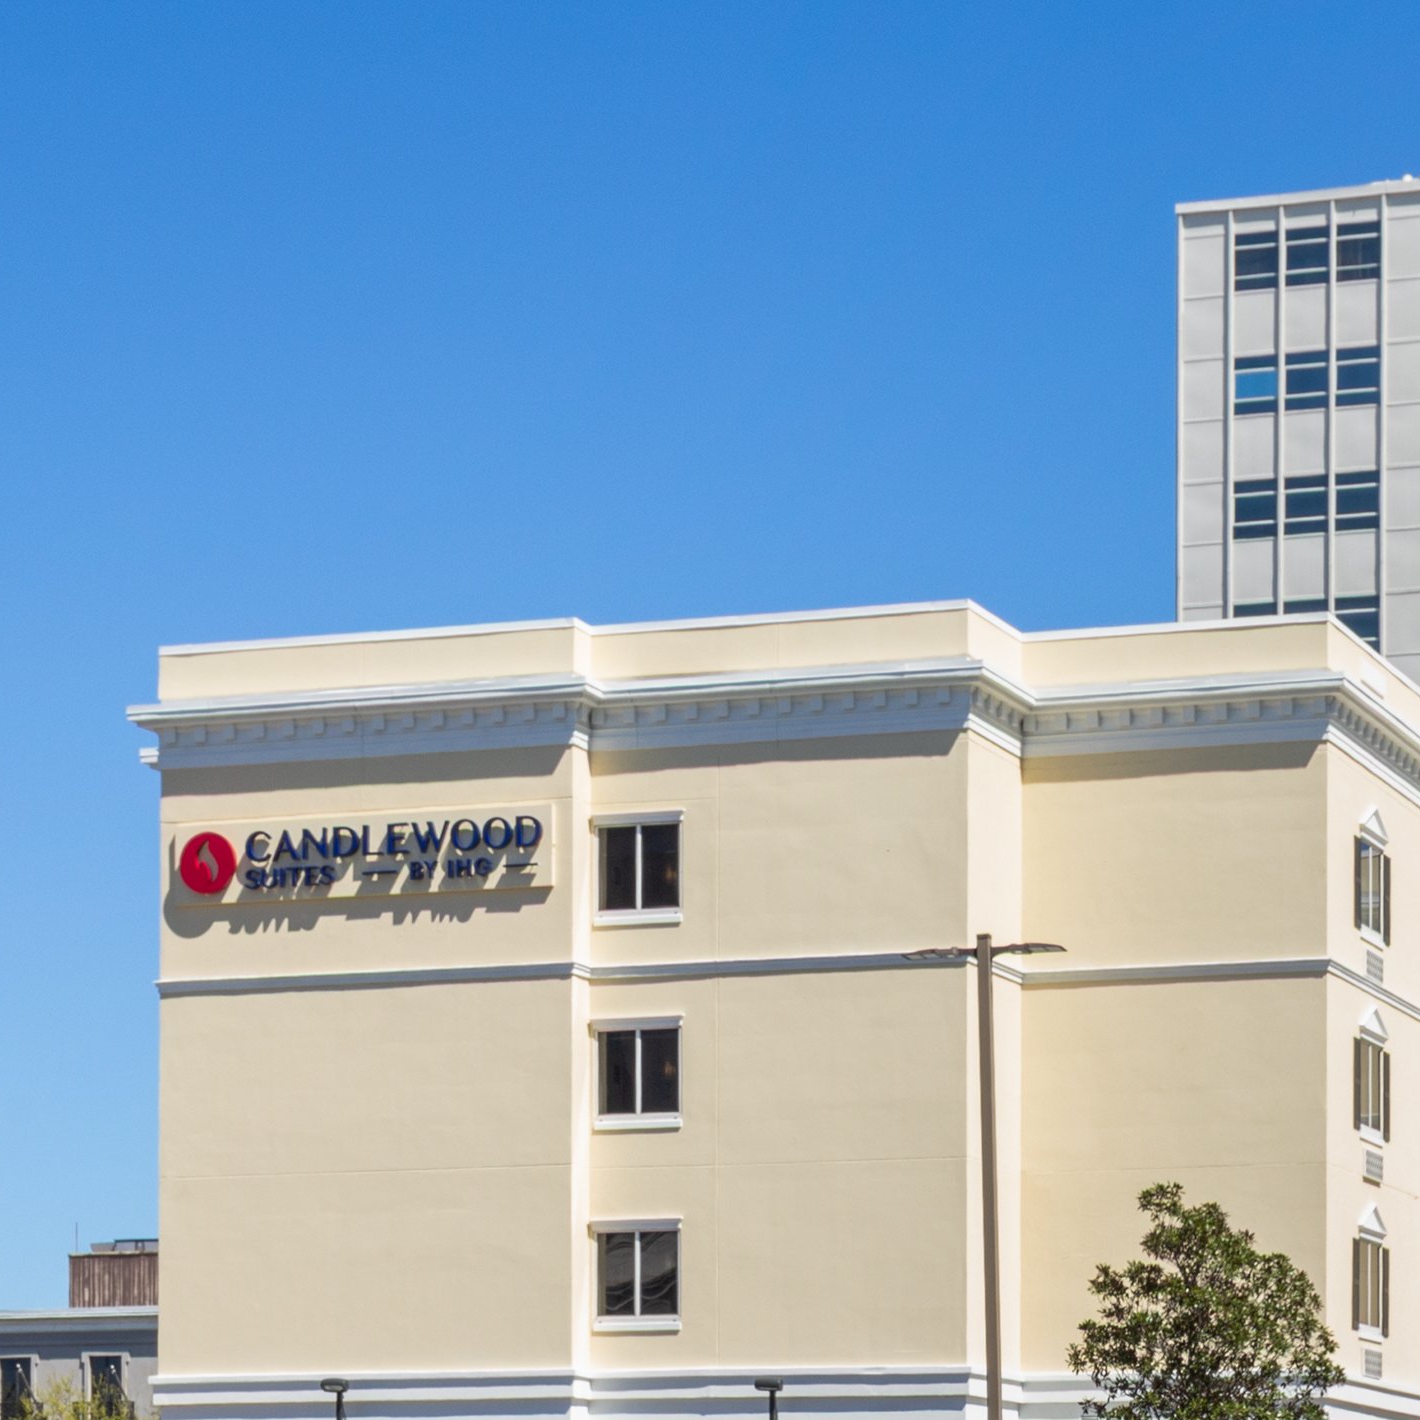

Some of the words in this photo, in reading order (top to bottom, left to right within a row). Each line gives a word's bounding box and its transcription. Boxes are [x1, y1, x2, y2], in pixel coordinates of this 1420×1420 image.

[245, 815, 543, 862] CANDLEWOOD
[245, 865, 335, 890] SUITES
[409, 861, 437, 881] BY
[447, 858, 493, 879] IHG
